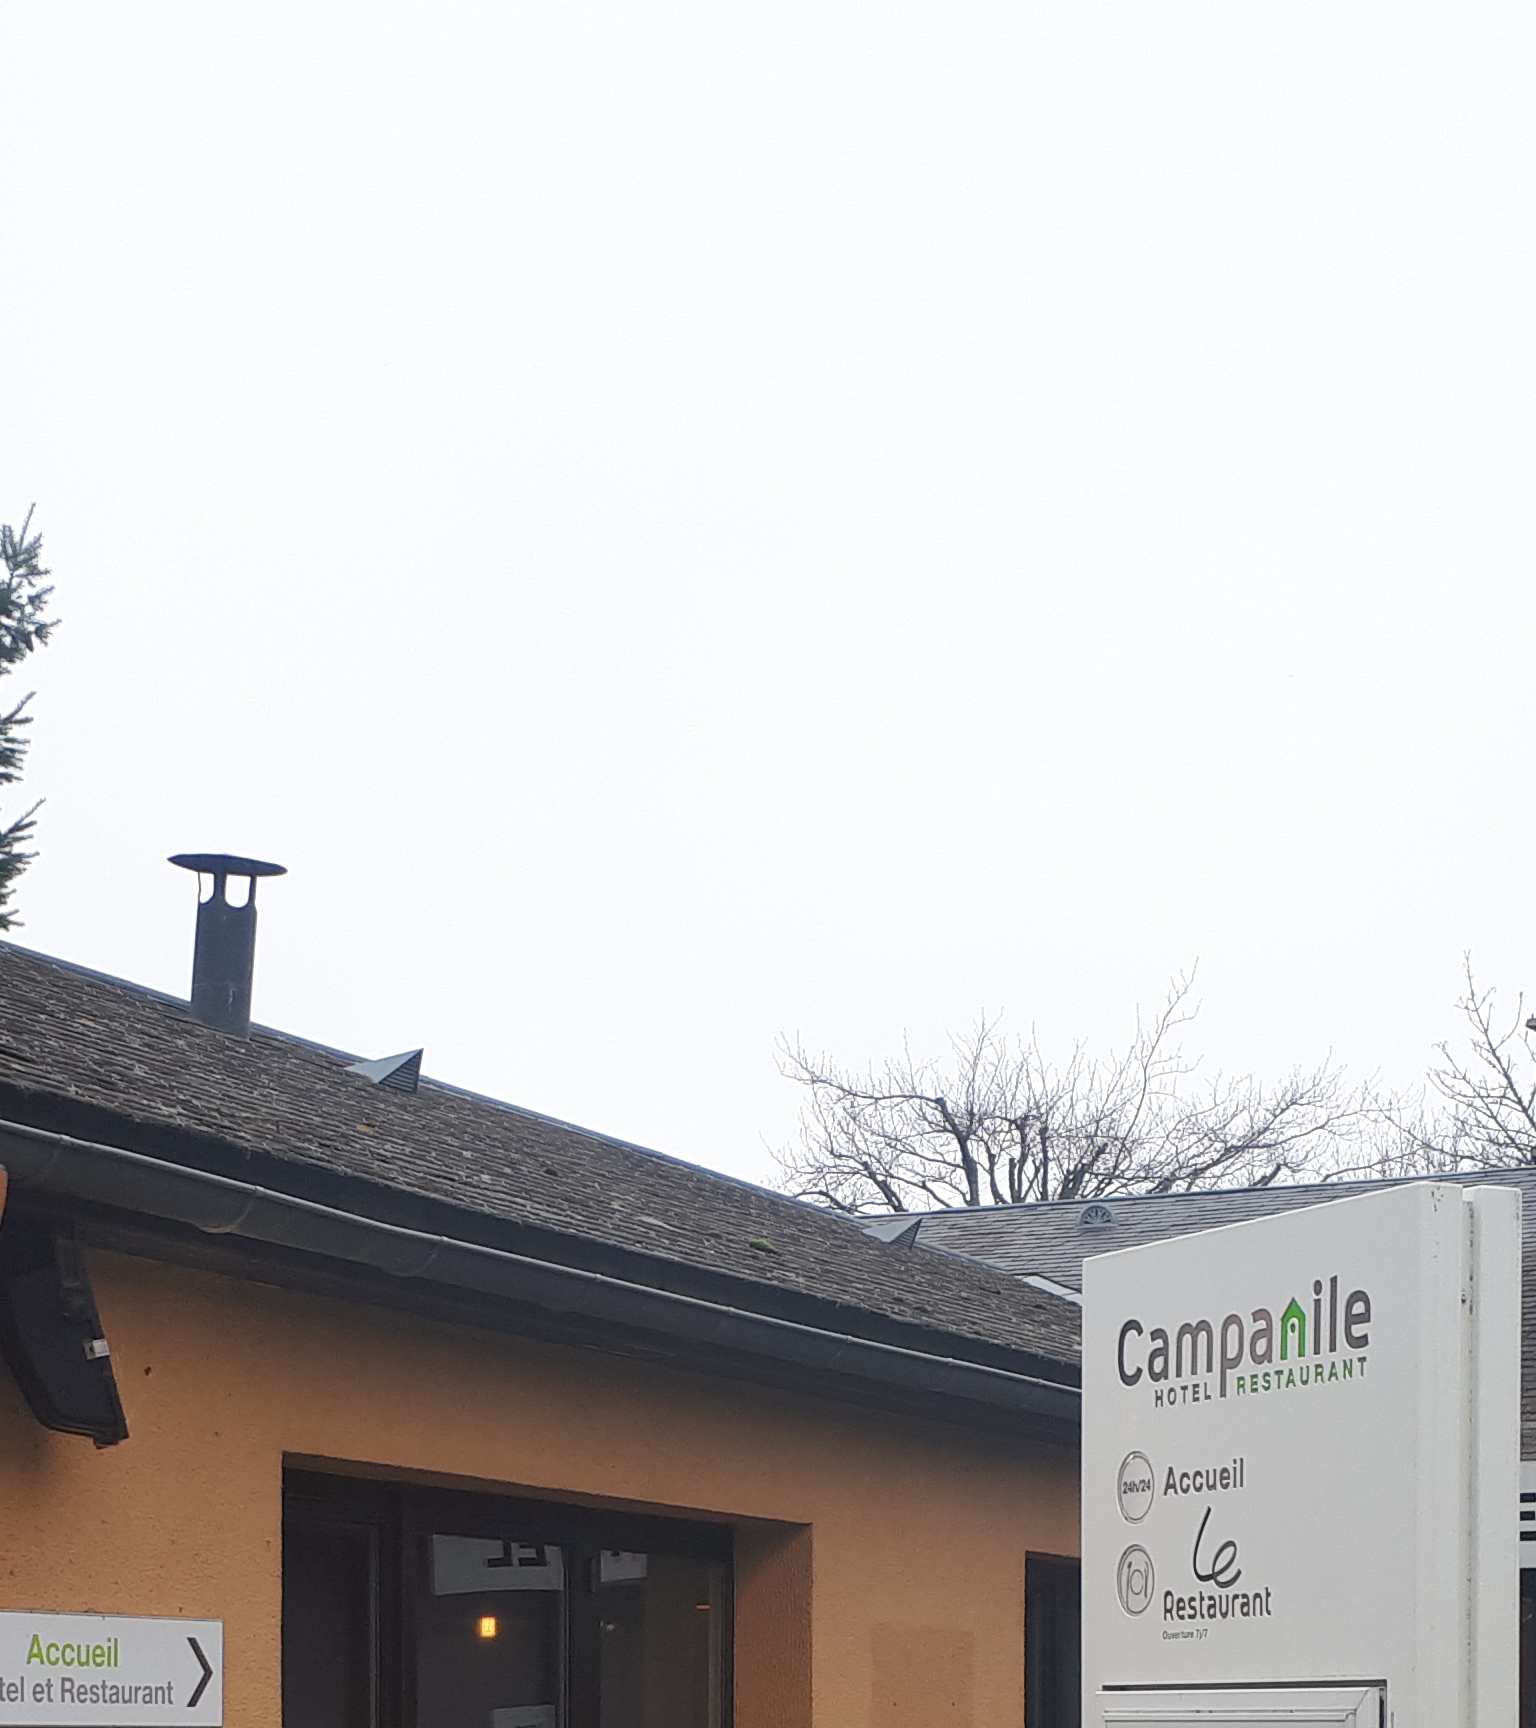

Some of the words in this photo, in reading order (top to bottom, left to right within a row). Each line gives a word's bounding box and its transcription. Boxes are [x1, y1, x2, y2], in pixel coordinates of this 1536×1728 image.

[1117, 1275, 1372, 1398] Campanile
[1154, 1381, 1213, 1408] HOTEL
[1236, 1356, 1368, 1397] RESTAURANT
[1122, 1479, 1151, 1494] 24h/24
[1163, 1457, 1244, 1497] Accueil
[1163, 1587, 1272, 1622] Restaurant
[26, 1634, 119, 1667] Accueil
[32, 1678, 54, 1703] et
[60, 1676, 174, 1705] Restaurant
